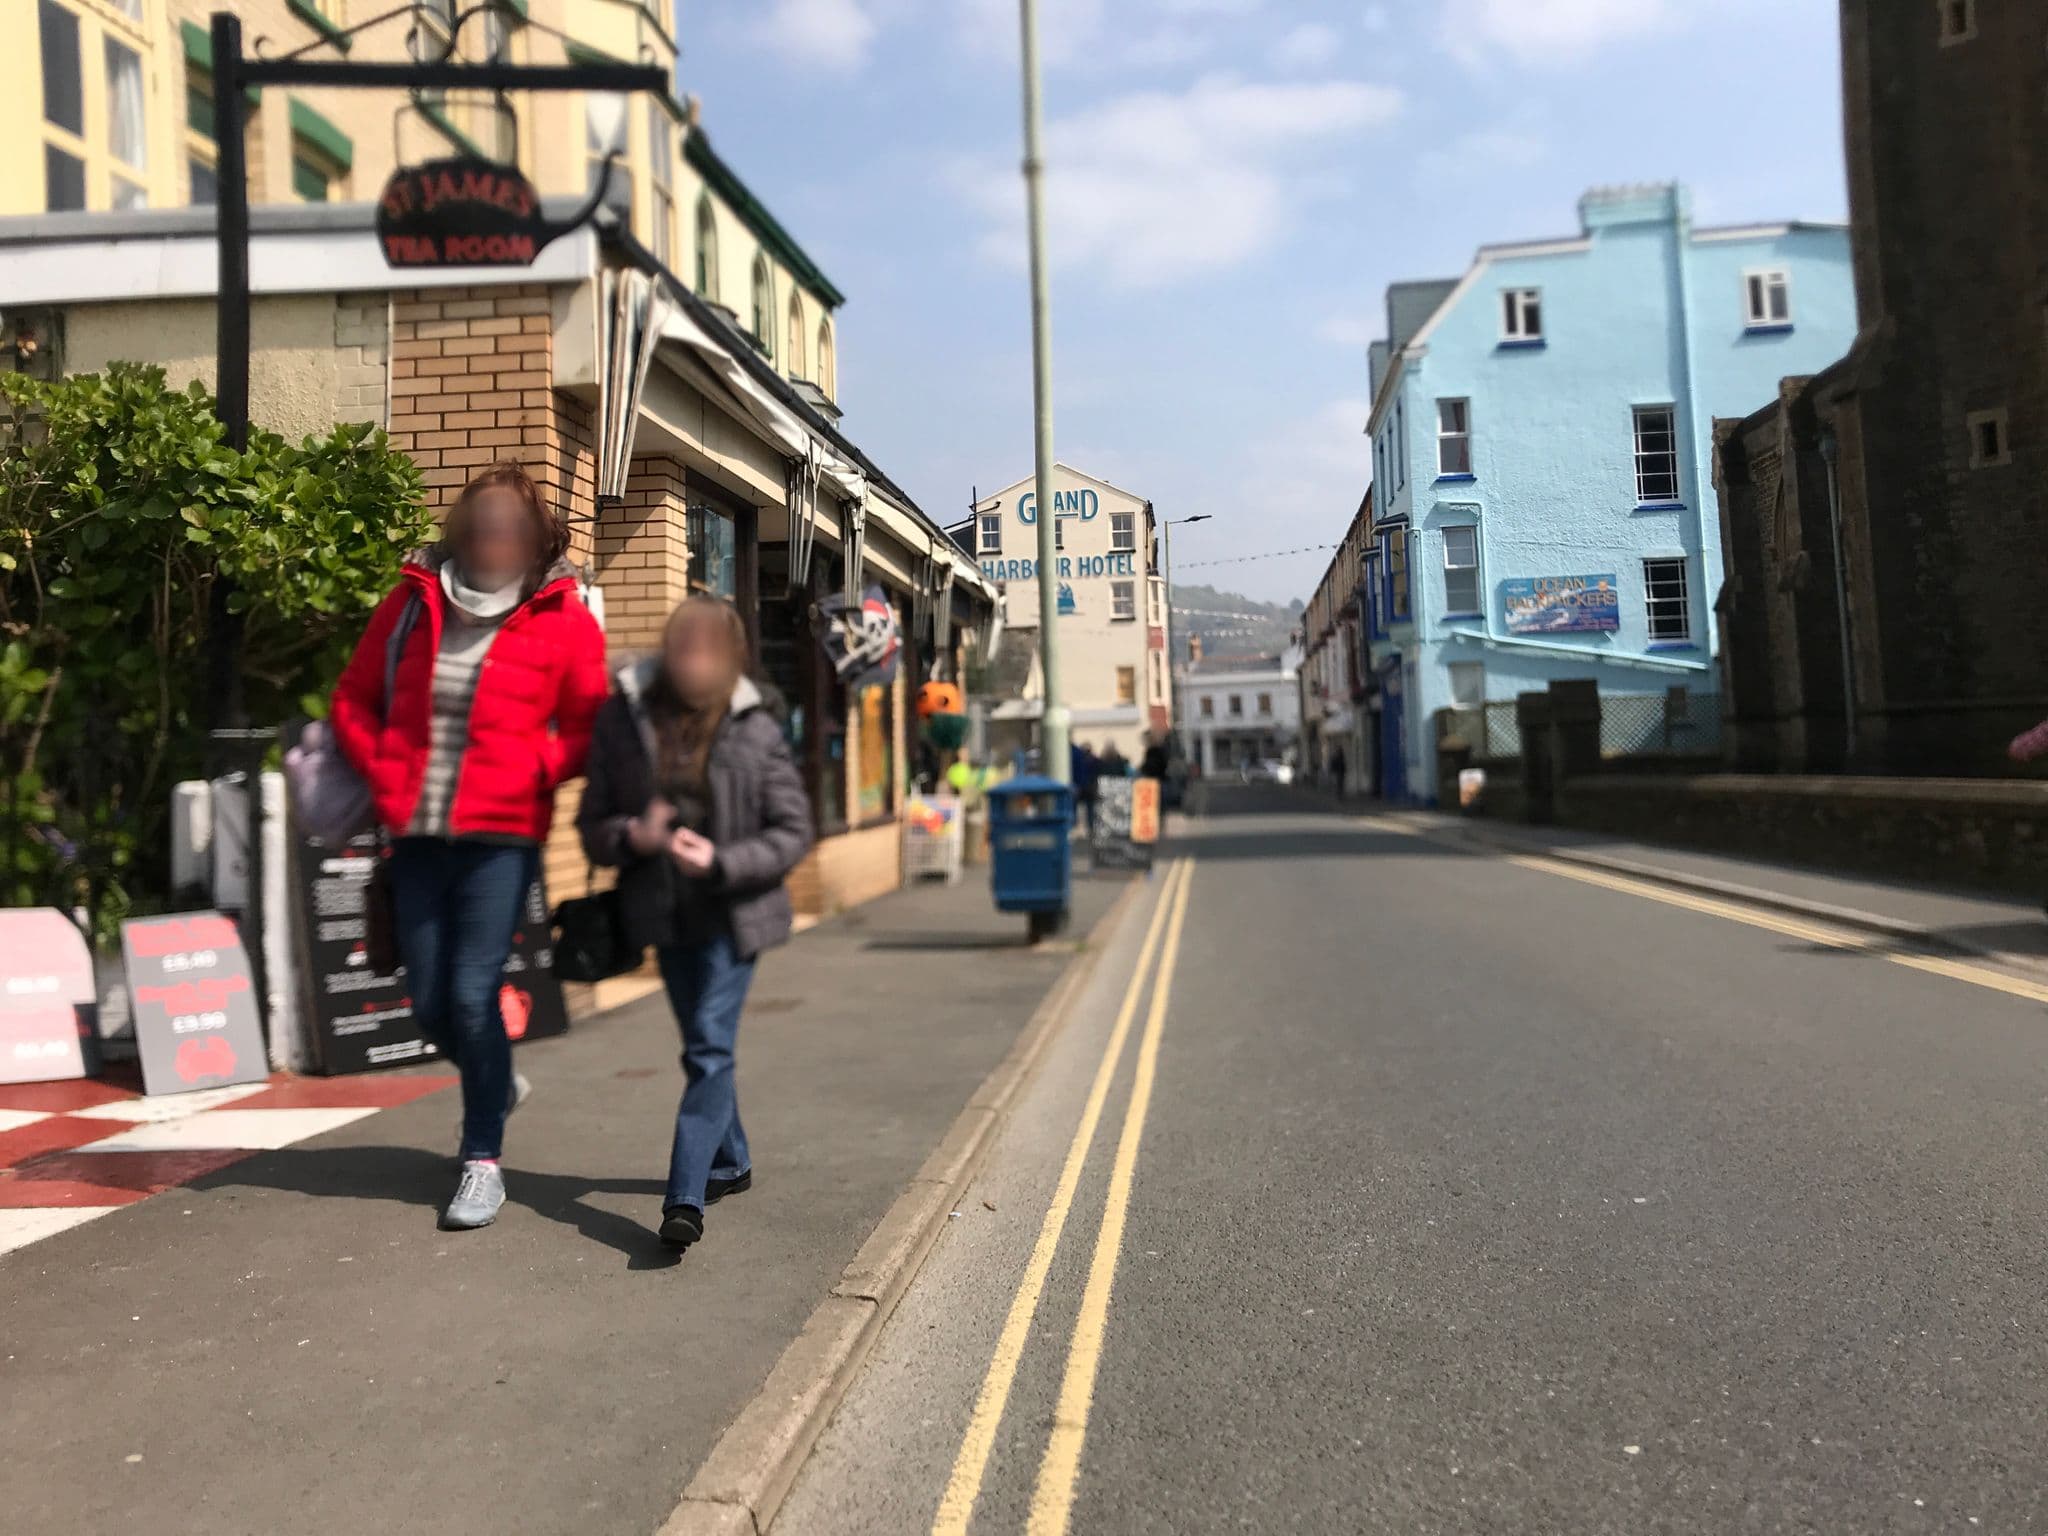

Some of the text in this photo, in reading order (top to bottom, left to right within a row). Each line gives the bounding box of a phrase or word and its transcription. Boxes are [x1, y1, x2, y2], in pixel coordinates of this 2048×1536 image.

[384, 234, 535, 263] TEA ROOM
[1018, 488, 1099, 525] GAND
[982, 552, 1136, 581] HARBR HOTEL
[1533, 576, 1586, 592] OCEAN
[1505, 591, 1618, 609] BACKPACKERS
